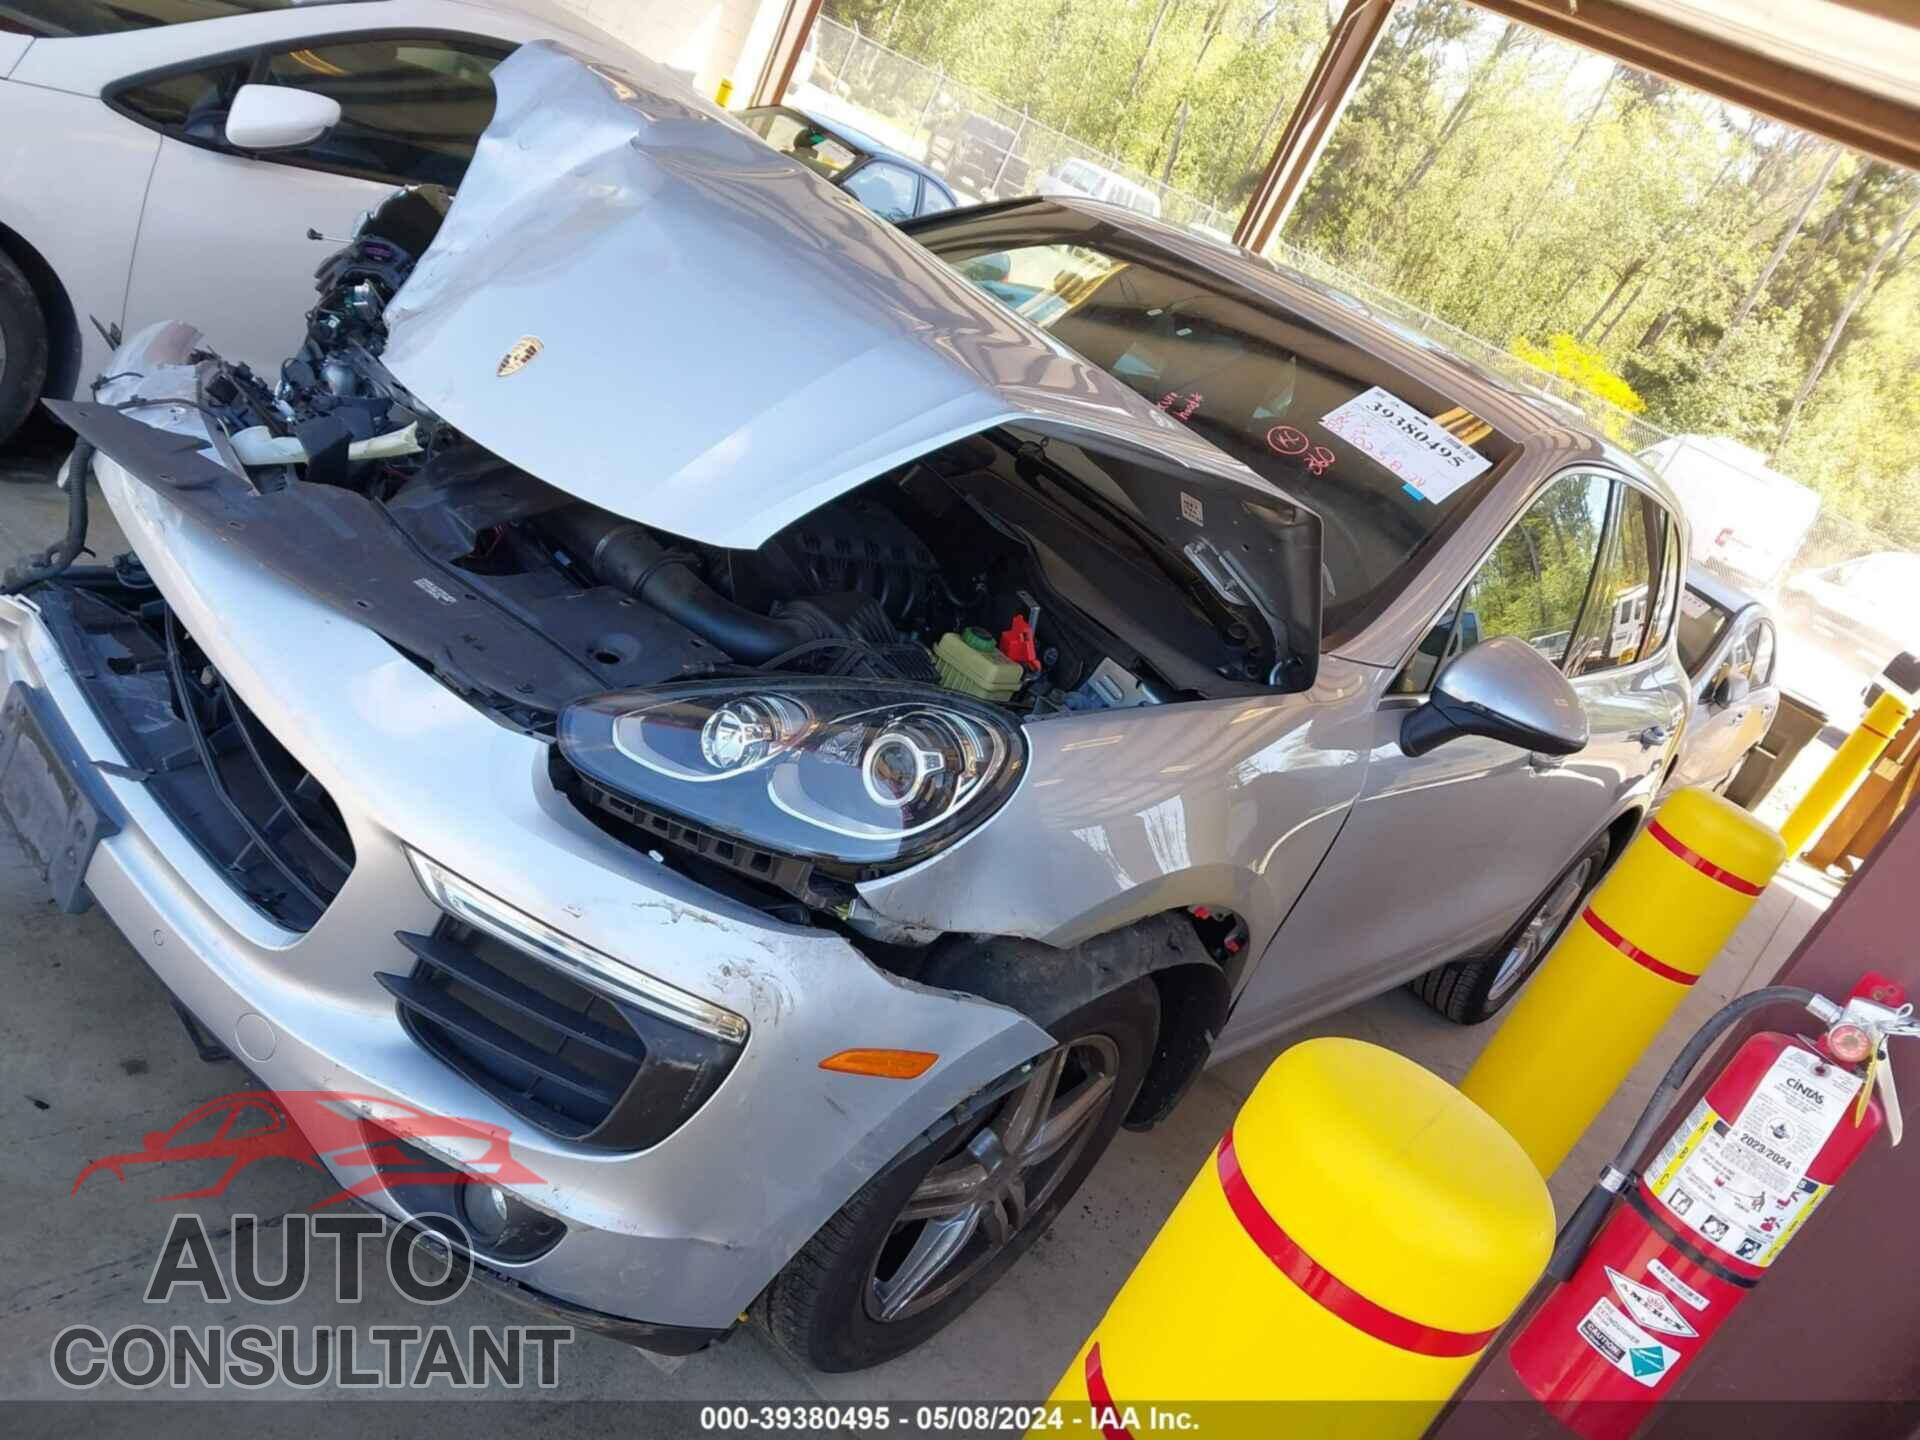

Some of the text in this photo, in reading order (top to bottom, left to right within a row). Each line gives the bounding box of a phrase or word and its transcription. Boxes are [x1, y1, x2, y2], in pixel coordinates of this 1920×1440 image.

[1365, 401, 1465, 468] 39380495
[1786, 1076, 1825, 1105] CINTAS
[1740, 1132, 1792, 1170] 2023/2024
